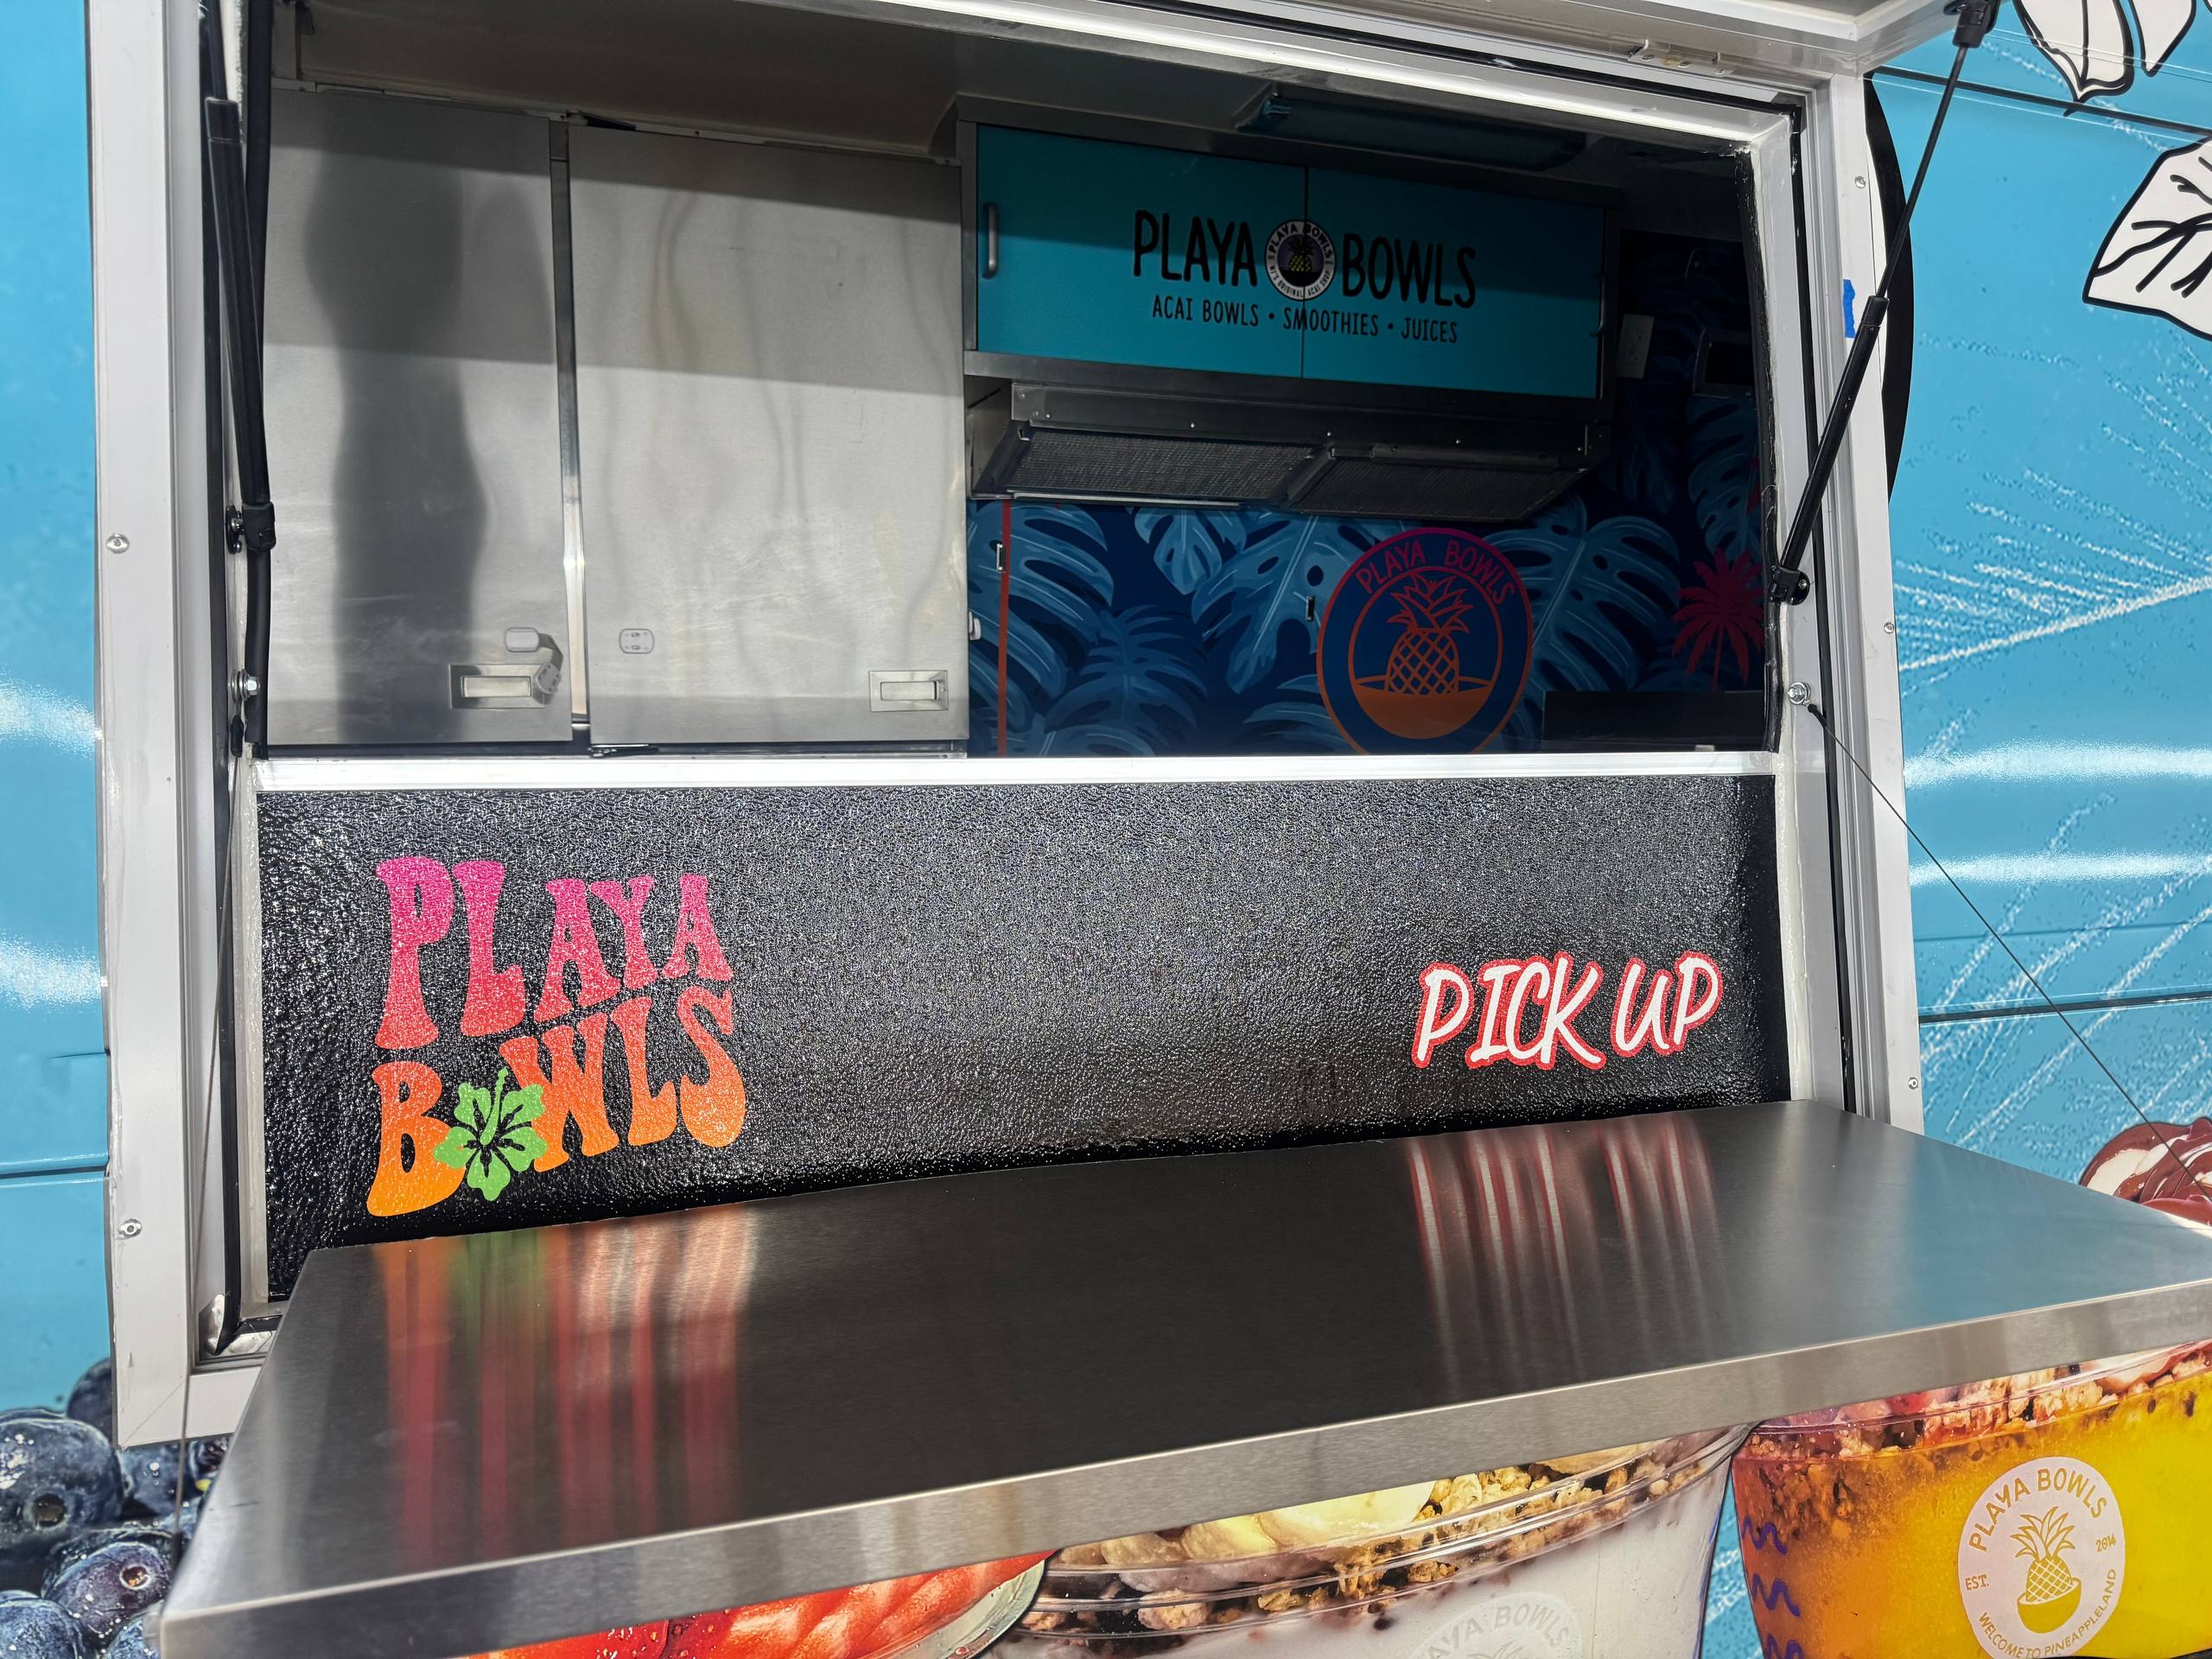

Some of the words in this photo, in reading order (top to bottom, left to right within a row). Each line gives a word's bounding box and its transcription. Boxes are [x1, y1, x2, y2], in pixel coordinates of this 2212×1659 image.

[1133, 210, 1258, 287] PLAYA
[1342, 233, 1477, 309] BOWLS
[1268, 224, 1298, 253] PLAYA
[1303, 224, 1332, 257] BOWLS
[1153, 295, 1193, 321] ACAI
[1203, 300, 1259, 327] BOWLS
[1282, 309, 1379, 337] SMOOTHIES
[1401, 317, 1458, 344] JUICES
[1355, 539, 1426, 594] PLAYA
[1445, 539, 1516, 605] BOWLS
[374, 856, 734, 1050] PLAYA
[1412, 951, 1606, 1071] PICK
[1611, 951, 1723, 1057] UP
[366, 986, 747, 1217] BWLS
[1968, 1478, 2030, 1552] PLAYA
[2037, 1467, 2107, 1519] BOWLS
[1965, 1573, 1989, 1591] EST.
[2095, 1534, 2117, 1553] 2014
[1427, 1617, 1484, 1659] AYA
[1494, 1603, 1570, 1648] BOWLS
[1979, 1611, 2024, 1659] WELCOME
[2025, 1648, 2041, 1659] TO
[2044, 1568, 2117, 1656] PINEAPPLELAND
